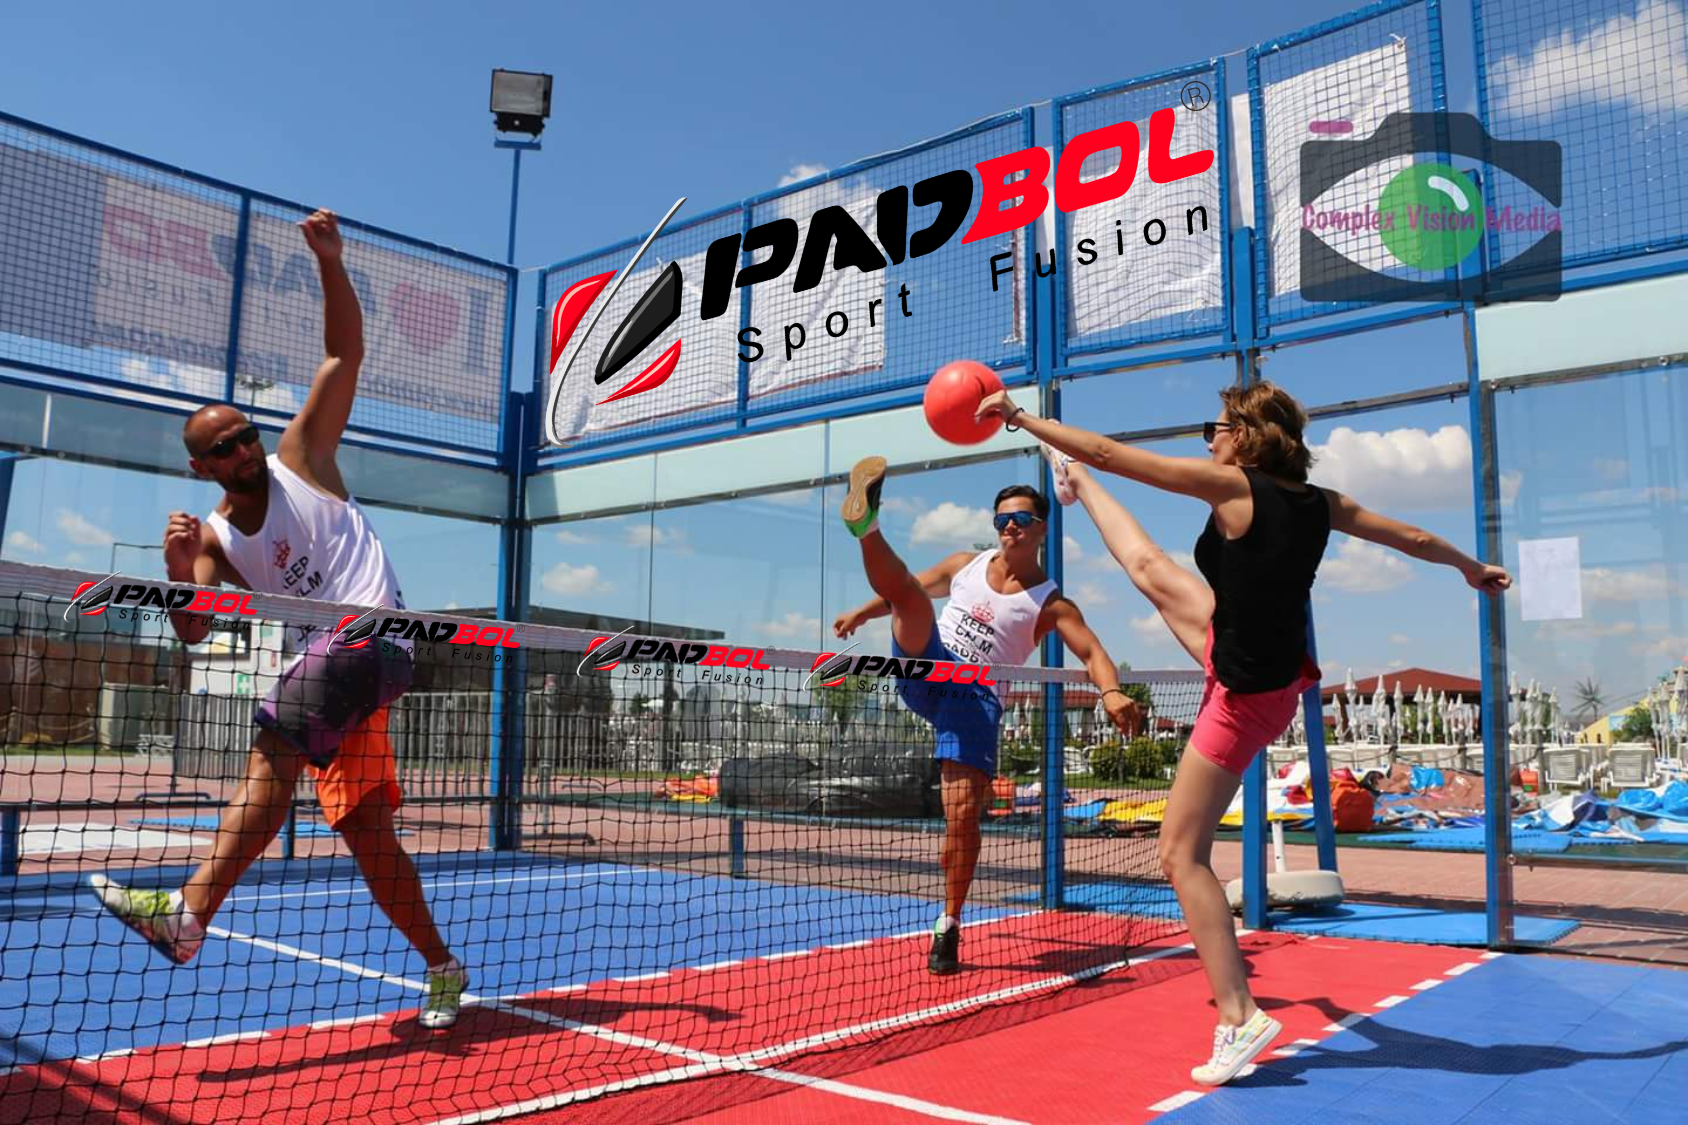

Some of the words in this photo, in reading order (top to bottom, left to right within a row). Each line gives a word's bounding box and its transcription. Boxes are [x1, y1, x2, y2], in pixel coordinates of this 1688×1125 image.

[283, 555, 309, 590] EEP
[296, 571, 323, 597] LM
[961, 613, 995, 637] KEEP
